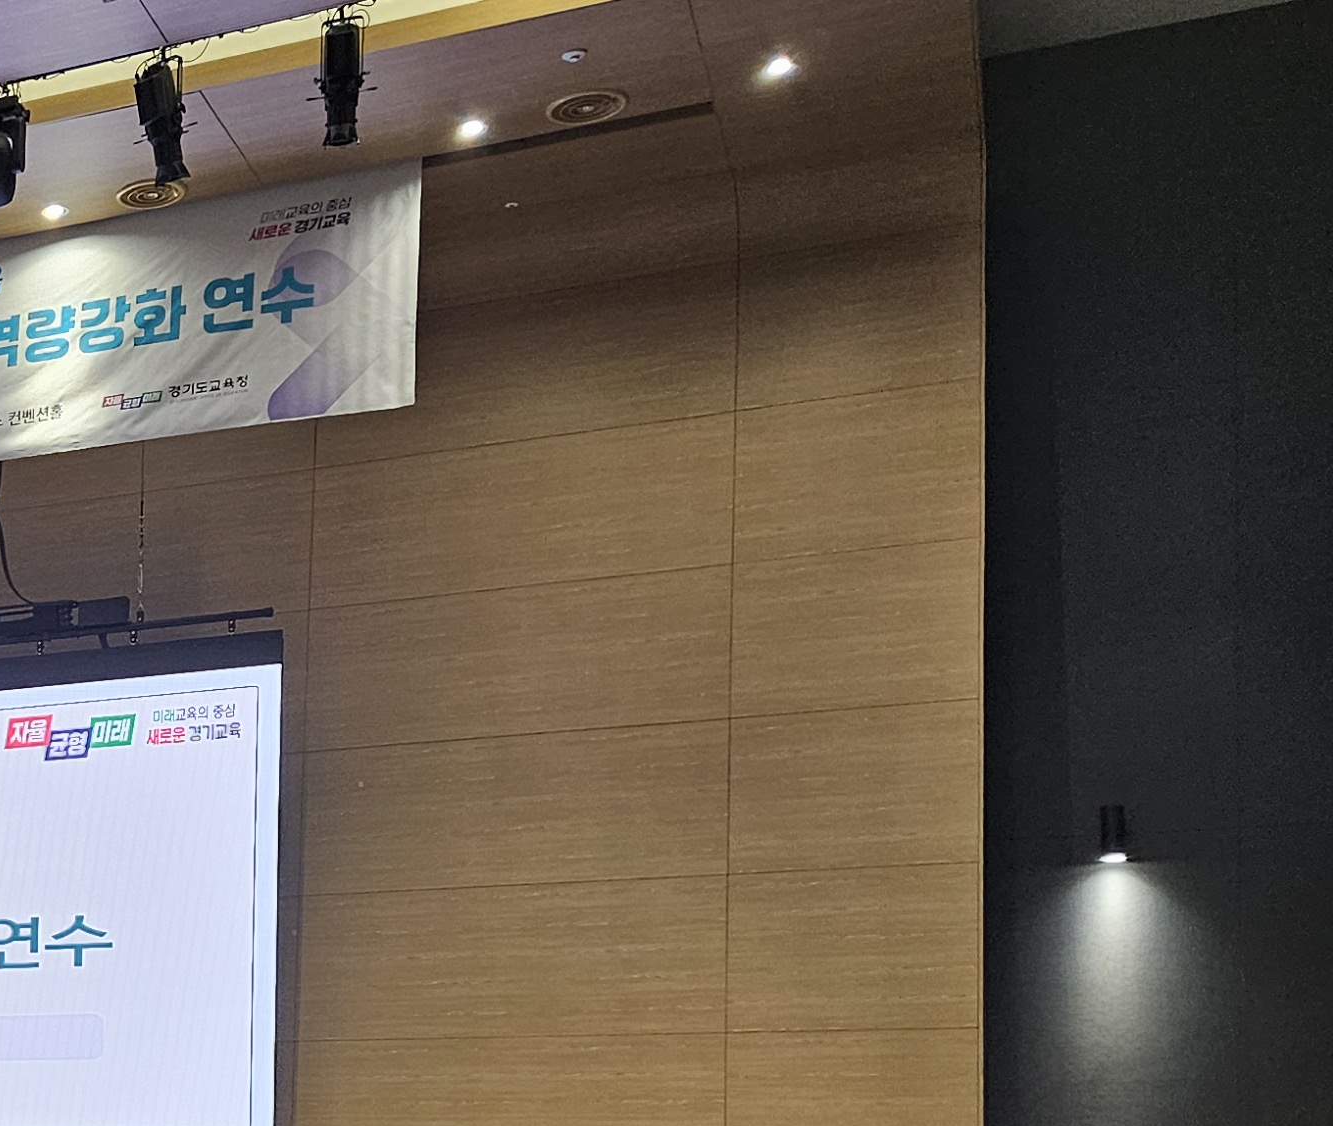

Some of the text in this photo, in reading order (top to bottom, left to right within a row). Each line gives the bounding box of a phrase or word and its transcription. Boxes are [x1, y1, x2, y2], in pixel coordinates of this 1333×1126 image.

[260, 197, 352, 223] 미래교육의 중심
[249, 212, 351, 241] 새로운 경기교육
[202, 266, 315, 335] 연수
[8, 403, 64, 426] 컨벤션홀
[153, 703, 236, 723] 미래교육의 중심
[10, 718, 132, 758] 자율 균형 미래
[147, 722, 241, 745] 새로운 경기교육
